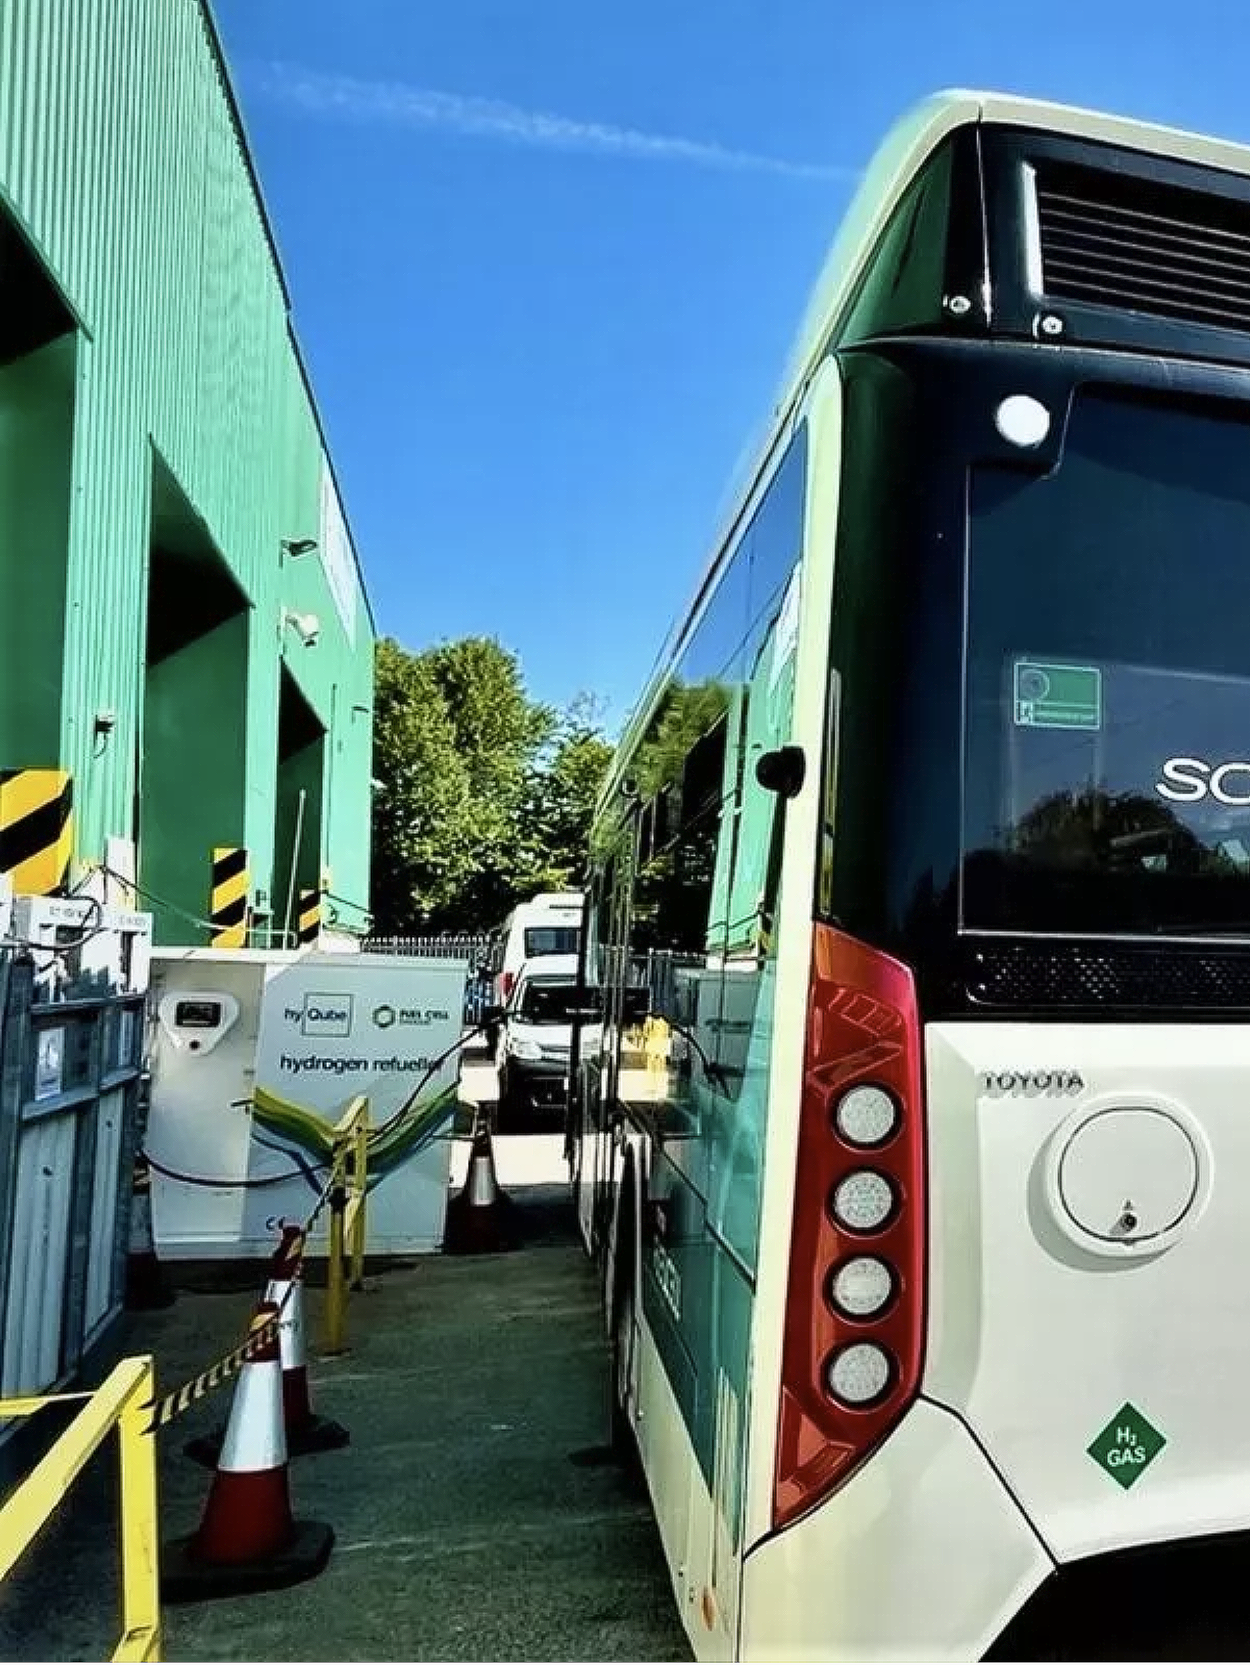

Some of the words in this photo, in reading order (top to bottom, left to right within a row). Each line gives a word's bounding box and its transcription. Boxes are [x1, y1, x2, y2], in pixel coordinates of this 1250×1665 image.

[280, 1055, 369, 1074] hydrogen
[373, 1055, 442, 1071] refuell
[981, 1070, 1084, 1091] TOYOTA
[1107, 1446, 1146, 1467] GAS
